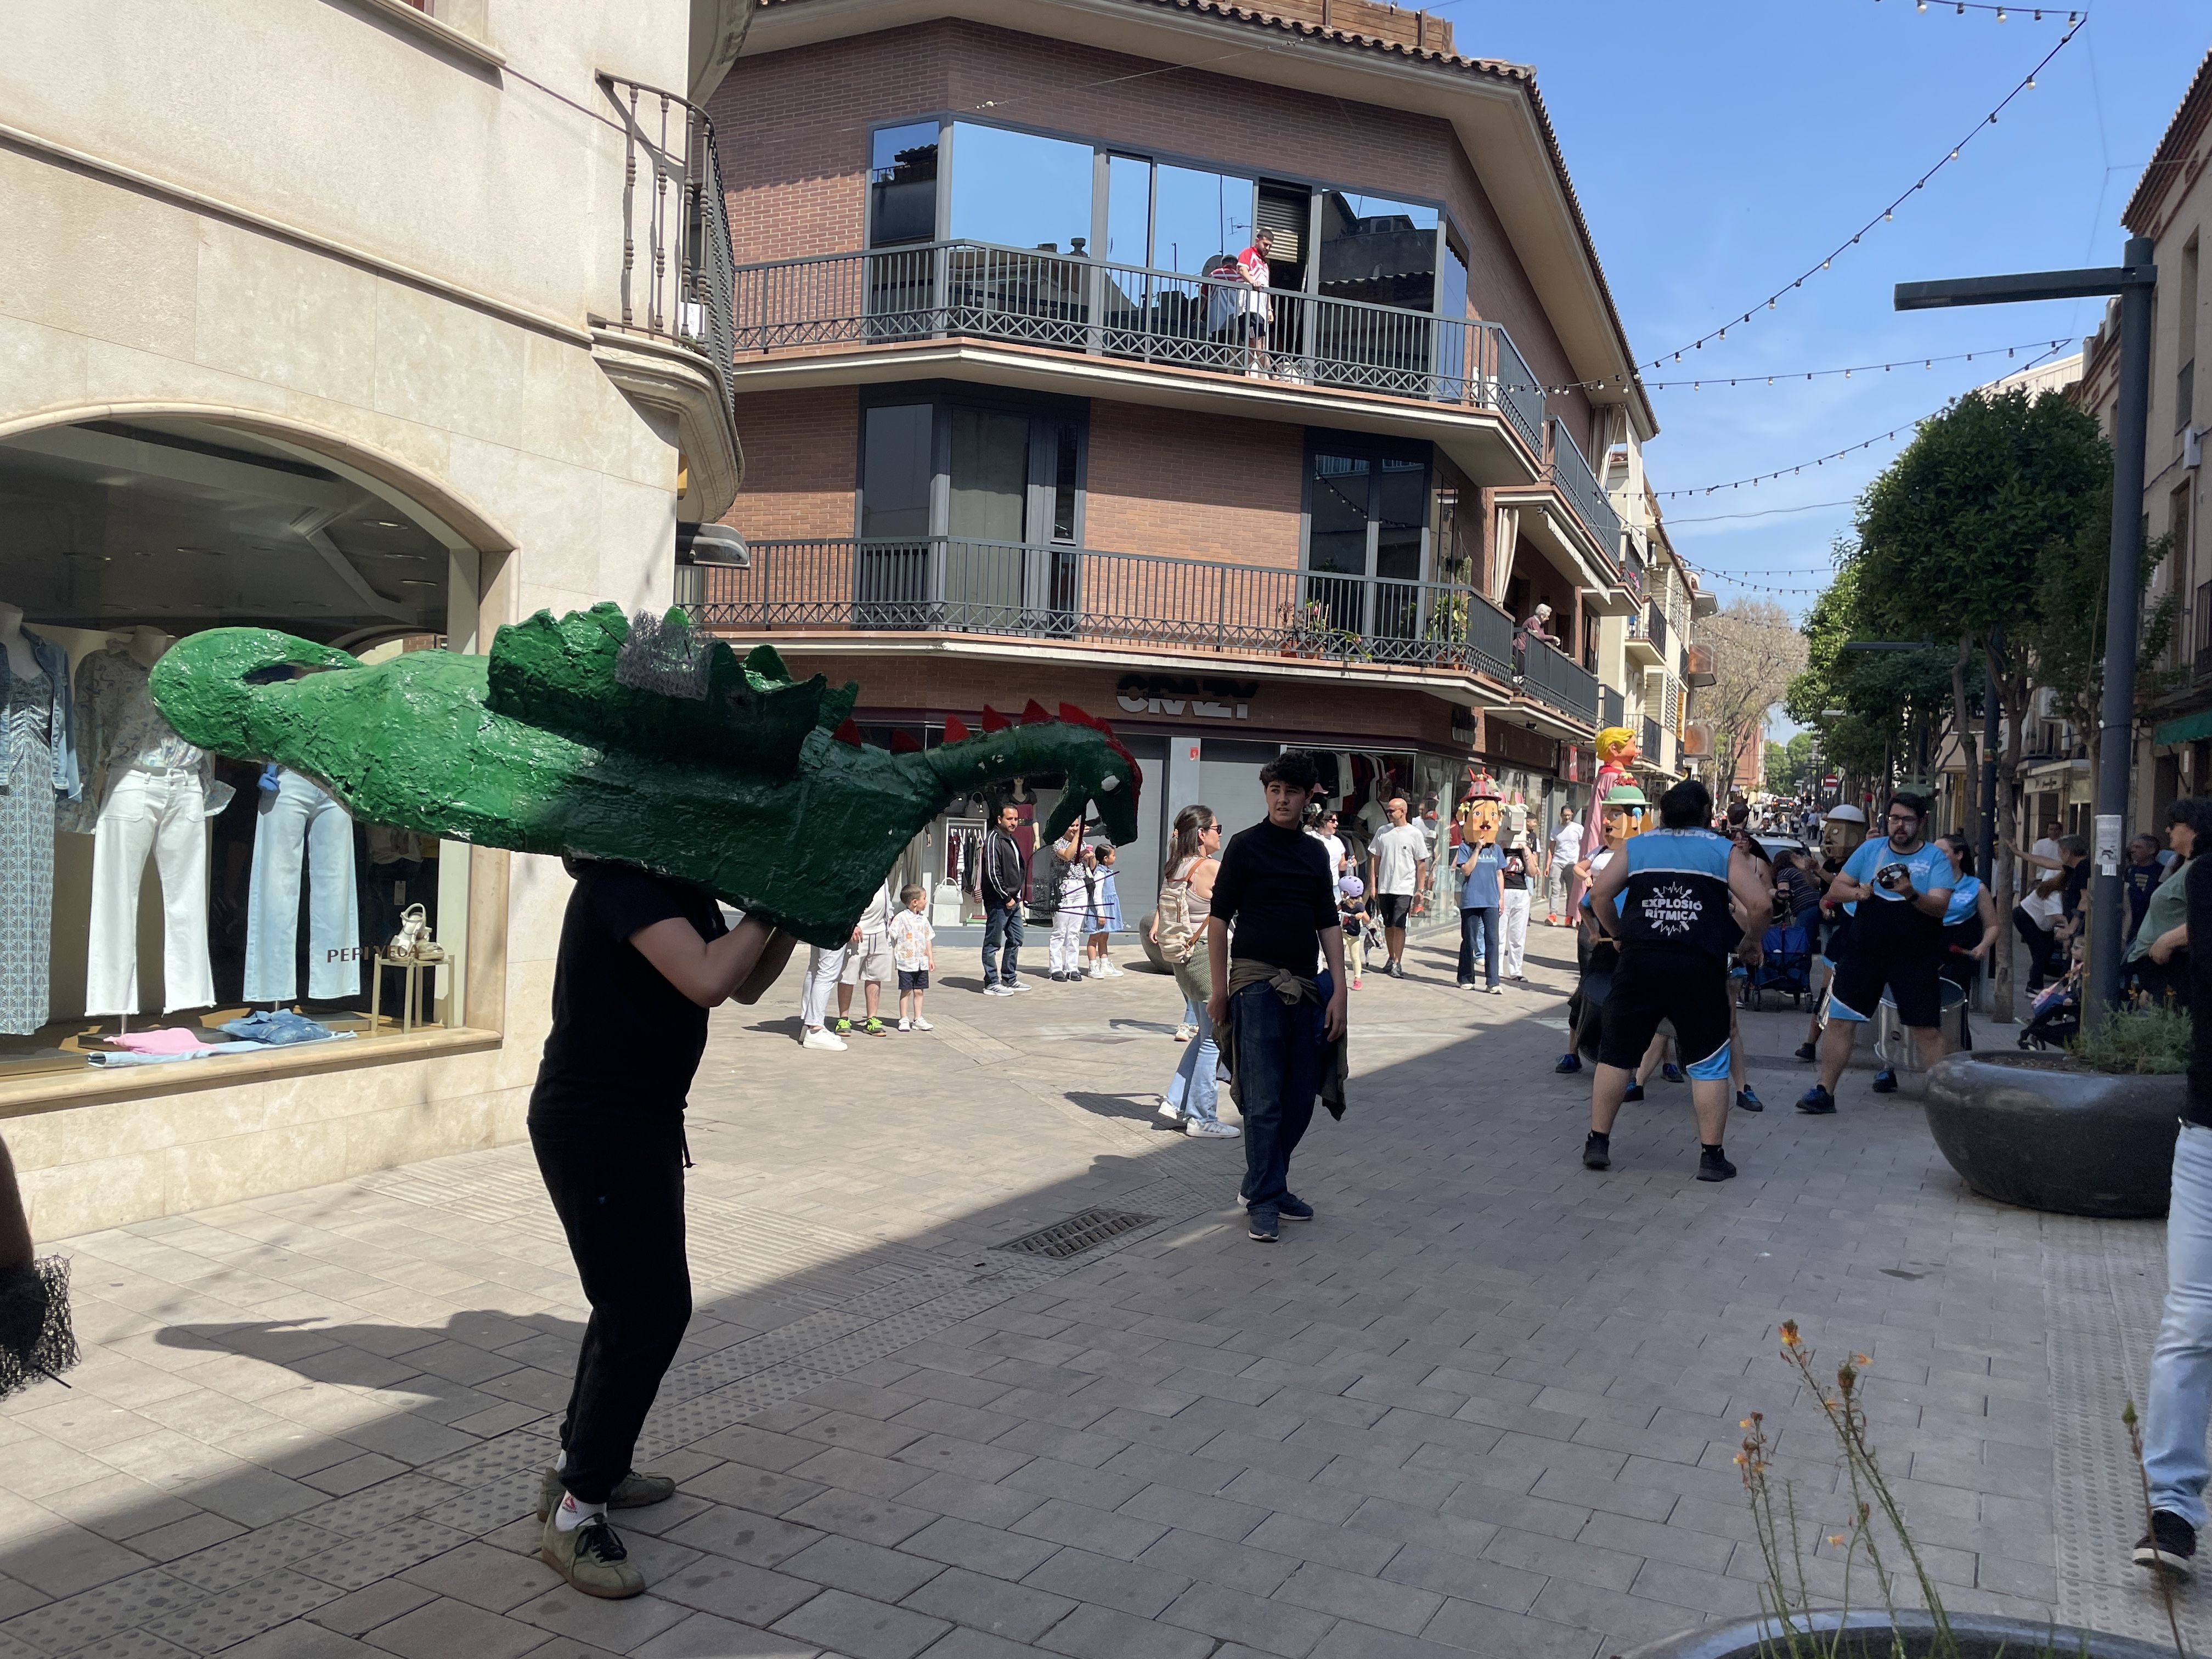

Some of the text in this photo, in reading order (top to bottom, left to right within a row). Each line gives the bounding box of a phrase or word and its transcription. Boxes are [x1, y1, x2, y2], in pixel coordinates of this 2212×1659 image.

[1641, 898, 1703, 911] EXPLOSIÓ
[1645, 908, 1699, 921] RÍTMICA
[326, 944, 419, 963] PEPI VEGA
